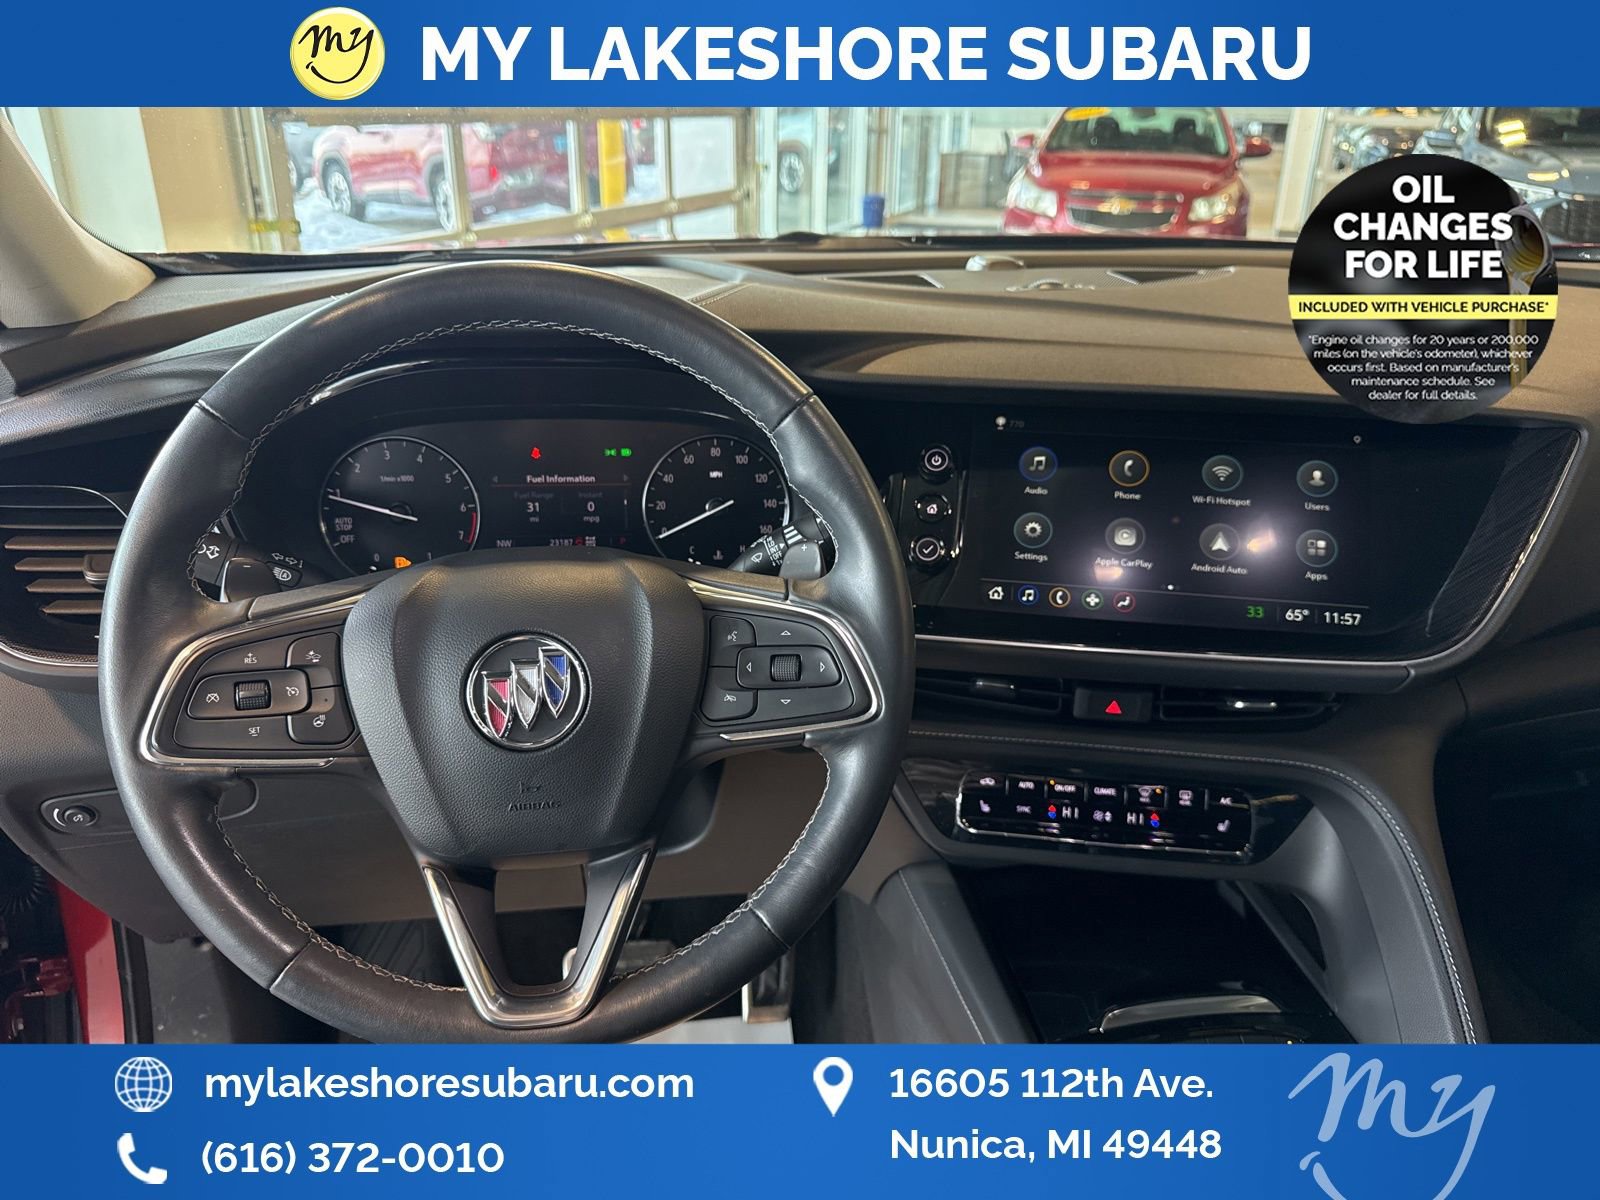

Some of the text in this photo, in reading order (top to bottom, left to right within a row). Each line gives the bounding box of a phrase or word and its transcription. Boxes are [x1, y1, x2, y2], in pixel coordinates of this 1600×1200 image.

[384, 451, 391, 461] 3
[710, 448, 721, 457] 80
[416, 454, 423, 464] 4
[684, 455, 695, 465] 60
[735, 455, 749, 465] 100
[354, 464, 361, 473] 2
[445, 474, 452, 484] 5
[526, 474, 596, 483] Fuel Information
[663, 474, 674, 484] 40
[709, 471, 723, 479] MPH
[755, 474, 768, 484] 120
[1024, 486, 1048, 495] Audio
[1114, 491, 1141, 501] Phone
[656, 501, 667, 510] 20
[763, 499, 777, 509] 140
[1192, 495, 1251, 508] Wi-Fi Hotspot
[460, 503, 467, 513] 6
[526, 502, 540, 513] 31
[587, 501, 595, 513] 0
[1304, 502, 1330, 512] Users
[335, 517, 353, 525] AUTO
[529, 515, 540, 523] mi
[583, 515, 600, 524] mpg
[760, 525, 773, 535] 160
[340, 535, 355, 544] OFF
[458, 531, 465, 540] 7
[496, 539, 512, 548] NW
[769, 545, 779, 554] INT
[373, 554, 380, 563] 0
[772, 551, 783, 561] OFF
[1014, 551, 1049, 563] Settings
[1095, 557, 1153, 570] Apple CarPlay
[1191, 563, 1248, 575] Android Auto
[1305, 571, 1328, 582] Apps
[1246, 606, 1264, 618] 33
[1285, 608, 1309, 622] 65°
[1323, 611, 1361, 626] 11:57
[244, 655, 257, 664] RES
[248, 726, 261, 734] SET
[1018, 781, 1035, 790] AUTO
[1054, 784, 1076, 793] ON/OFF
[1093, 787, 1117, 797] CLIMATE
[508, 800, 560, 811] AIRBAG
[1016, 805, 1032, 814] SYNC
